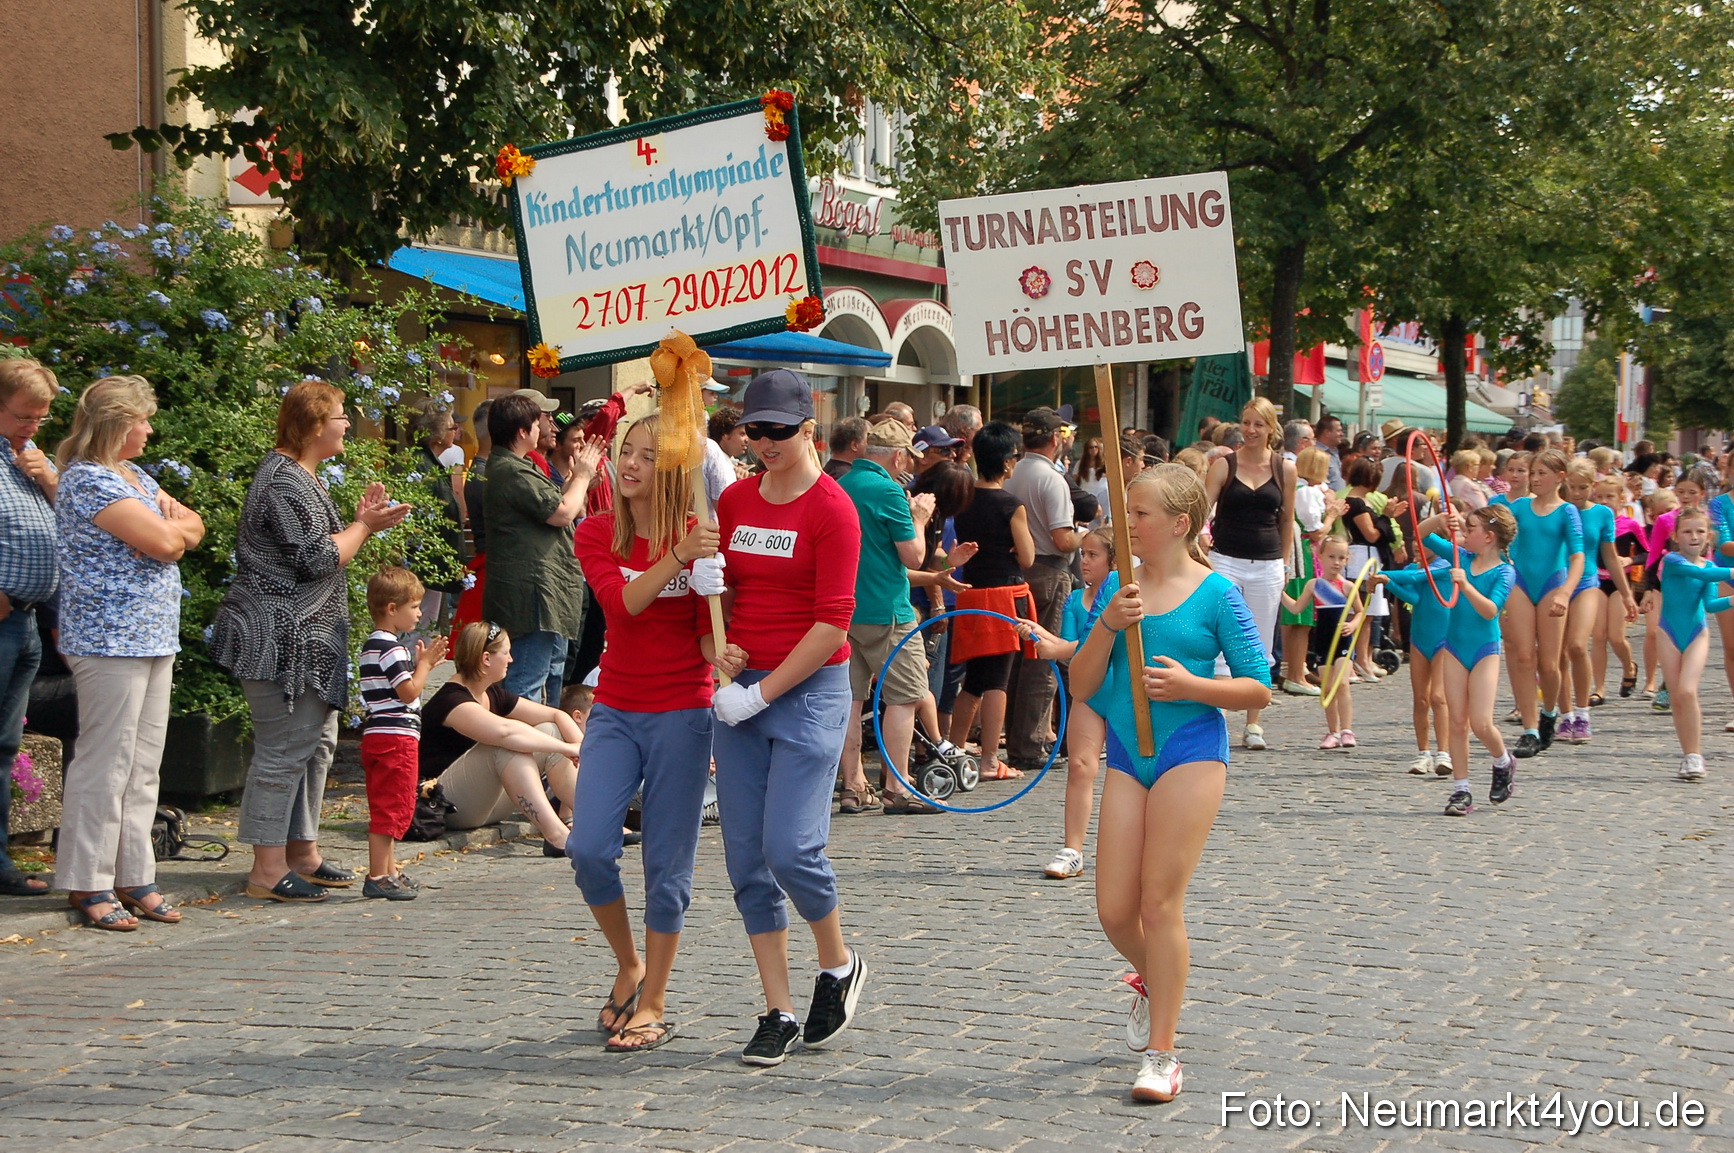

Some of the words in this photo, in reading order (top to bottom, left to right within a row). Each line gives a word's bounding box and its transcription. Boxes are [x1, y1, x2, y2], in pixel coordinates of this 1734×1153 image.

[636, 137, 658, 166] 4.
[525, 143, 784, 228] Kinderturnolympiade
[814, 177, 884, 238] Bögerl
[565, 193, 769, 276] Neumarkt/Opf.
[944, 189, 1226, 252] TURNABTEILUNG
[1065, 258, 1113, 297] SV
[984, 301, 1205, 356] HÖHENBERG
[765, 534, 792, 551] 600
